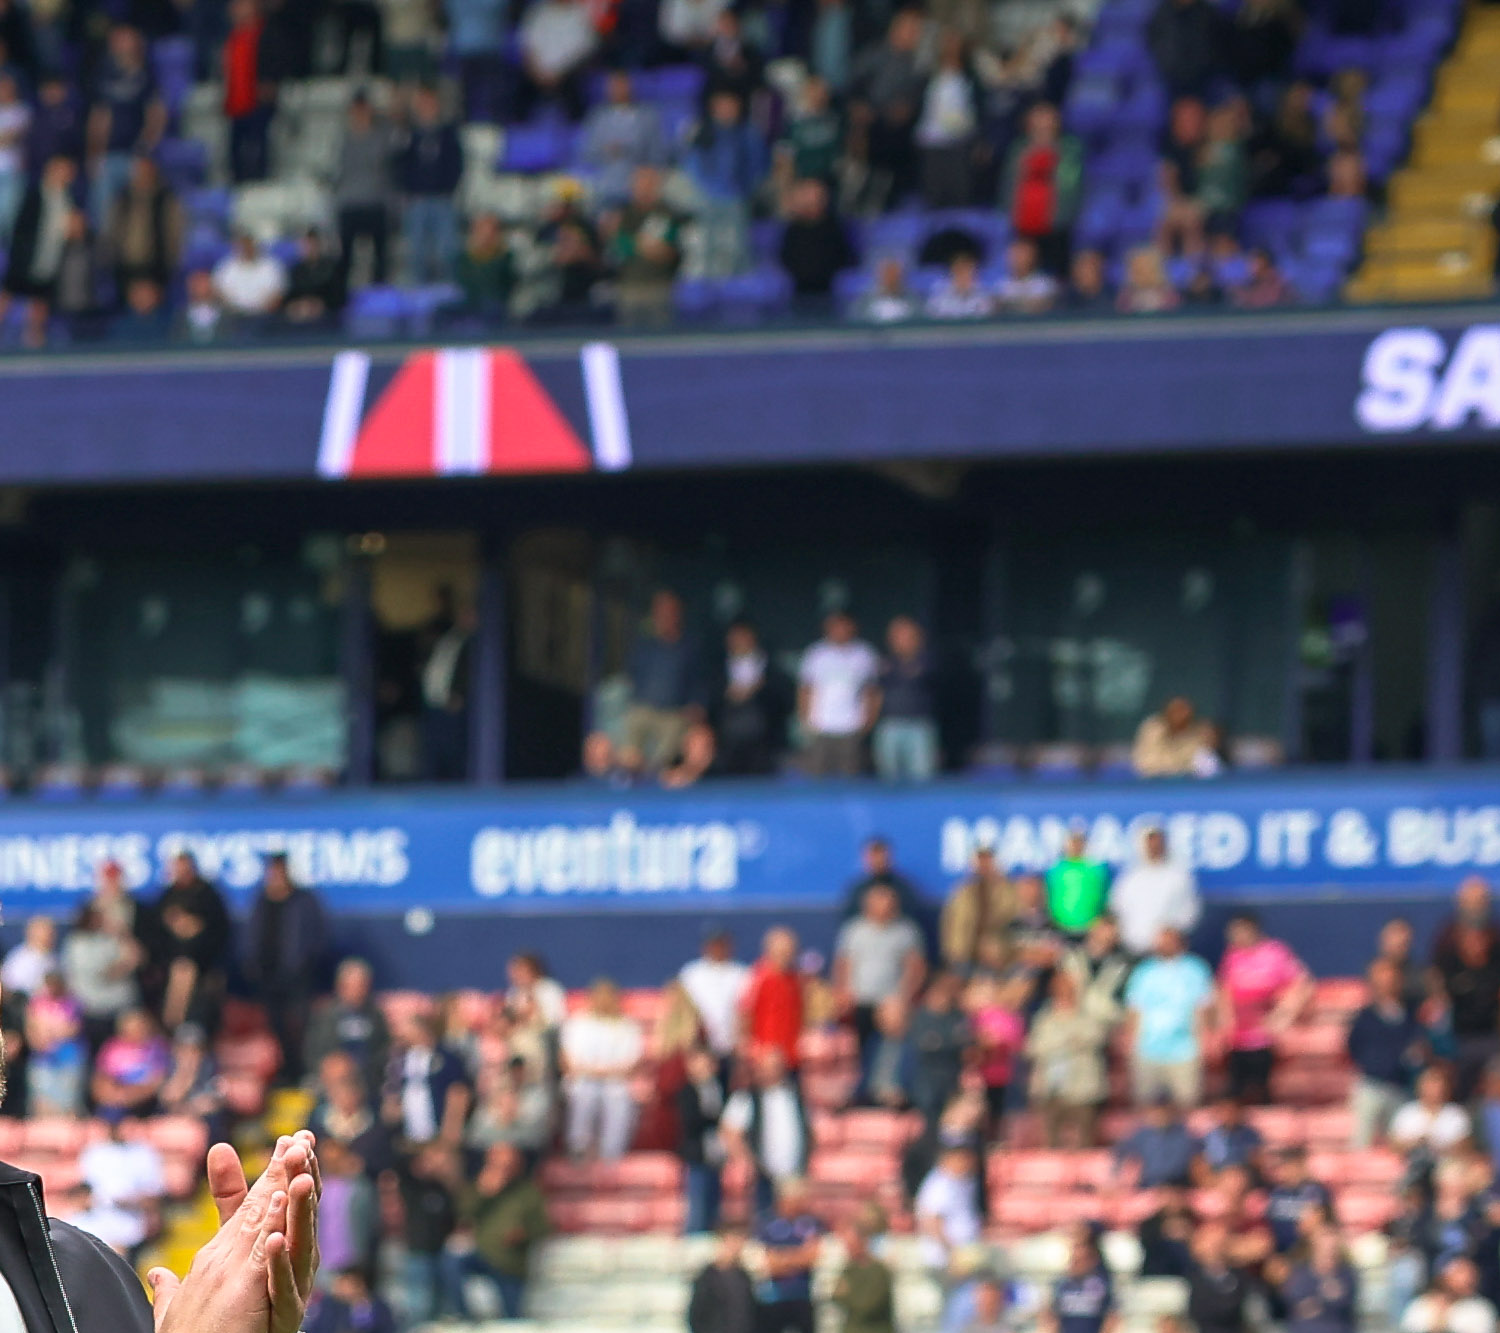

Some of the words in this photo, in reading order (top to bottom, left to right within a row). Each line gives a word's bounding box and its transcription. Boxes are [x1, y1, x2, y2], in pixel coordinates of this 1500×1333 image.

[471, 810, 739, 897] eventura
[1257, 809, 1320, 868] IT
[1325, 809, 1377, 868] &
